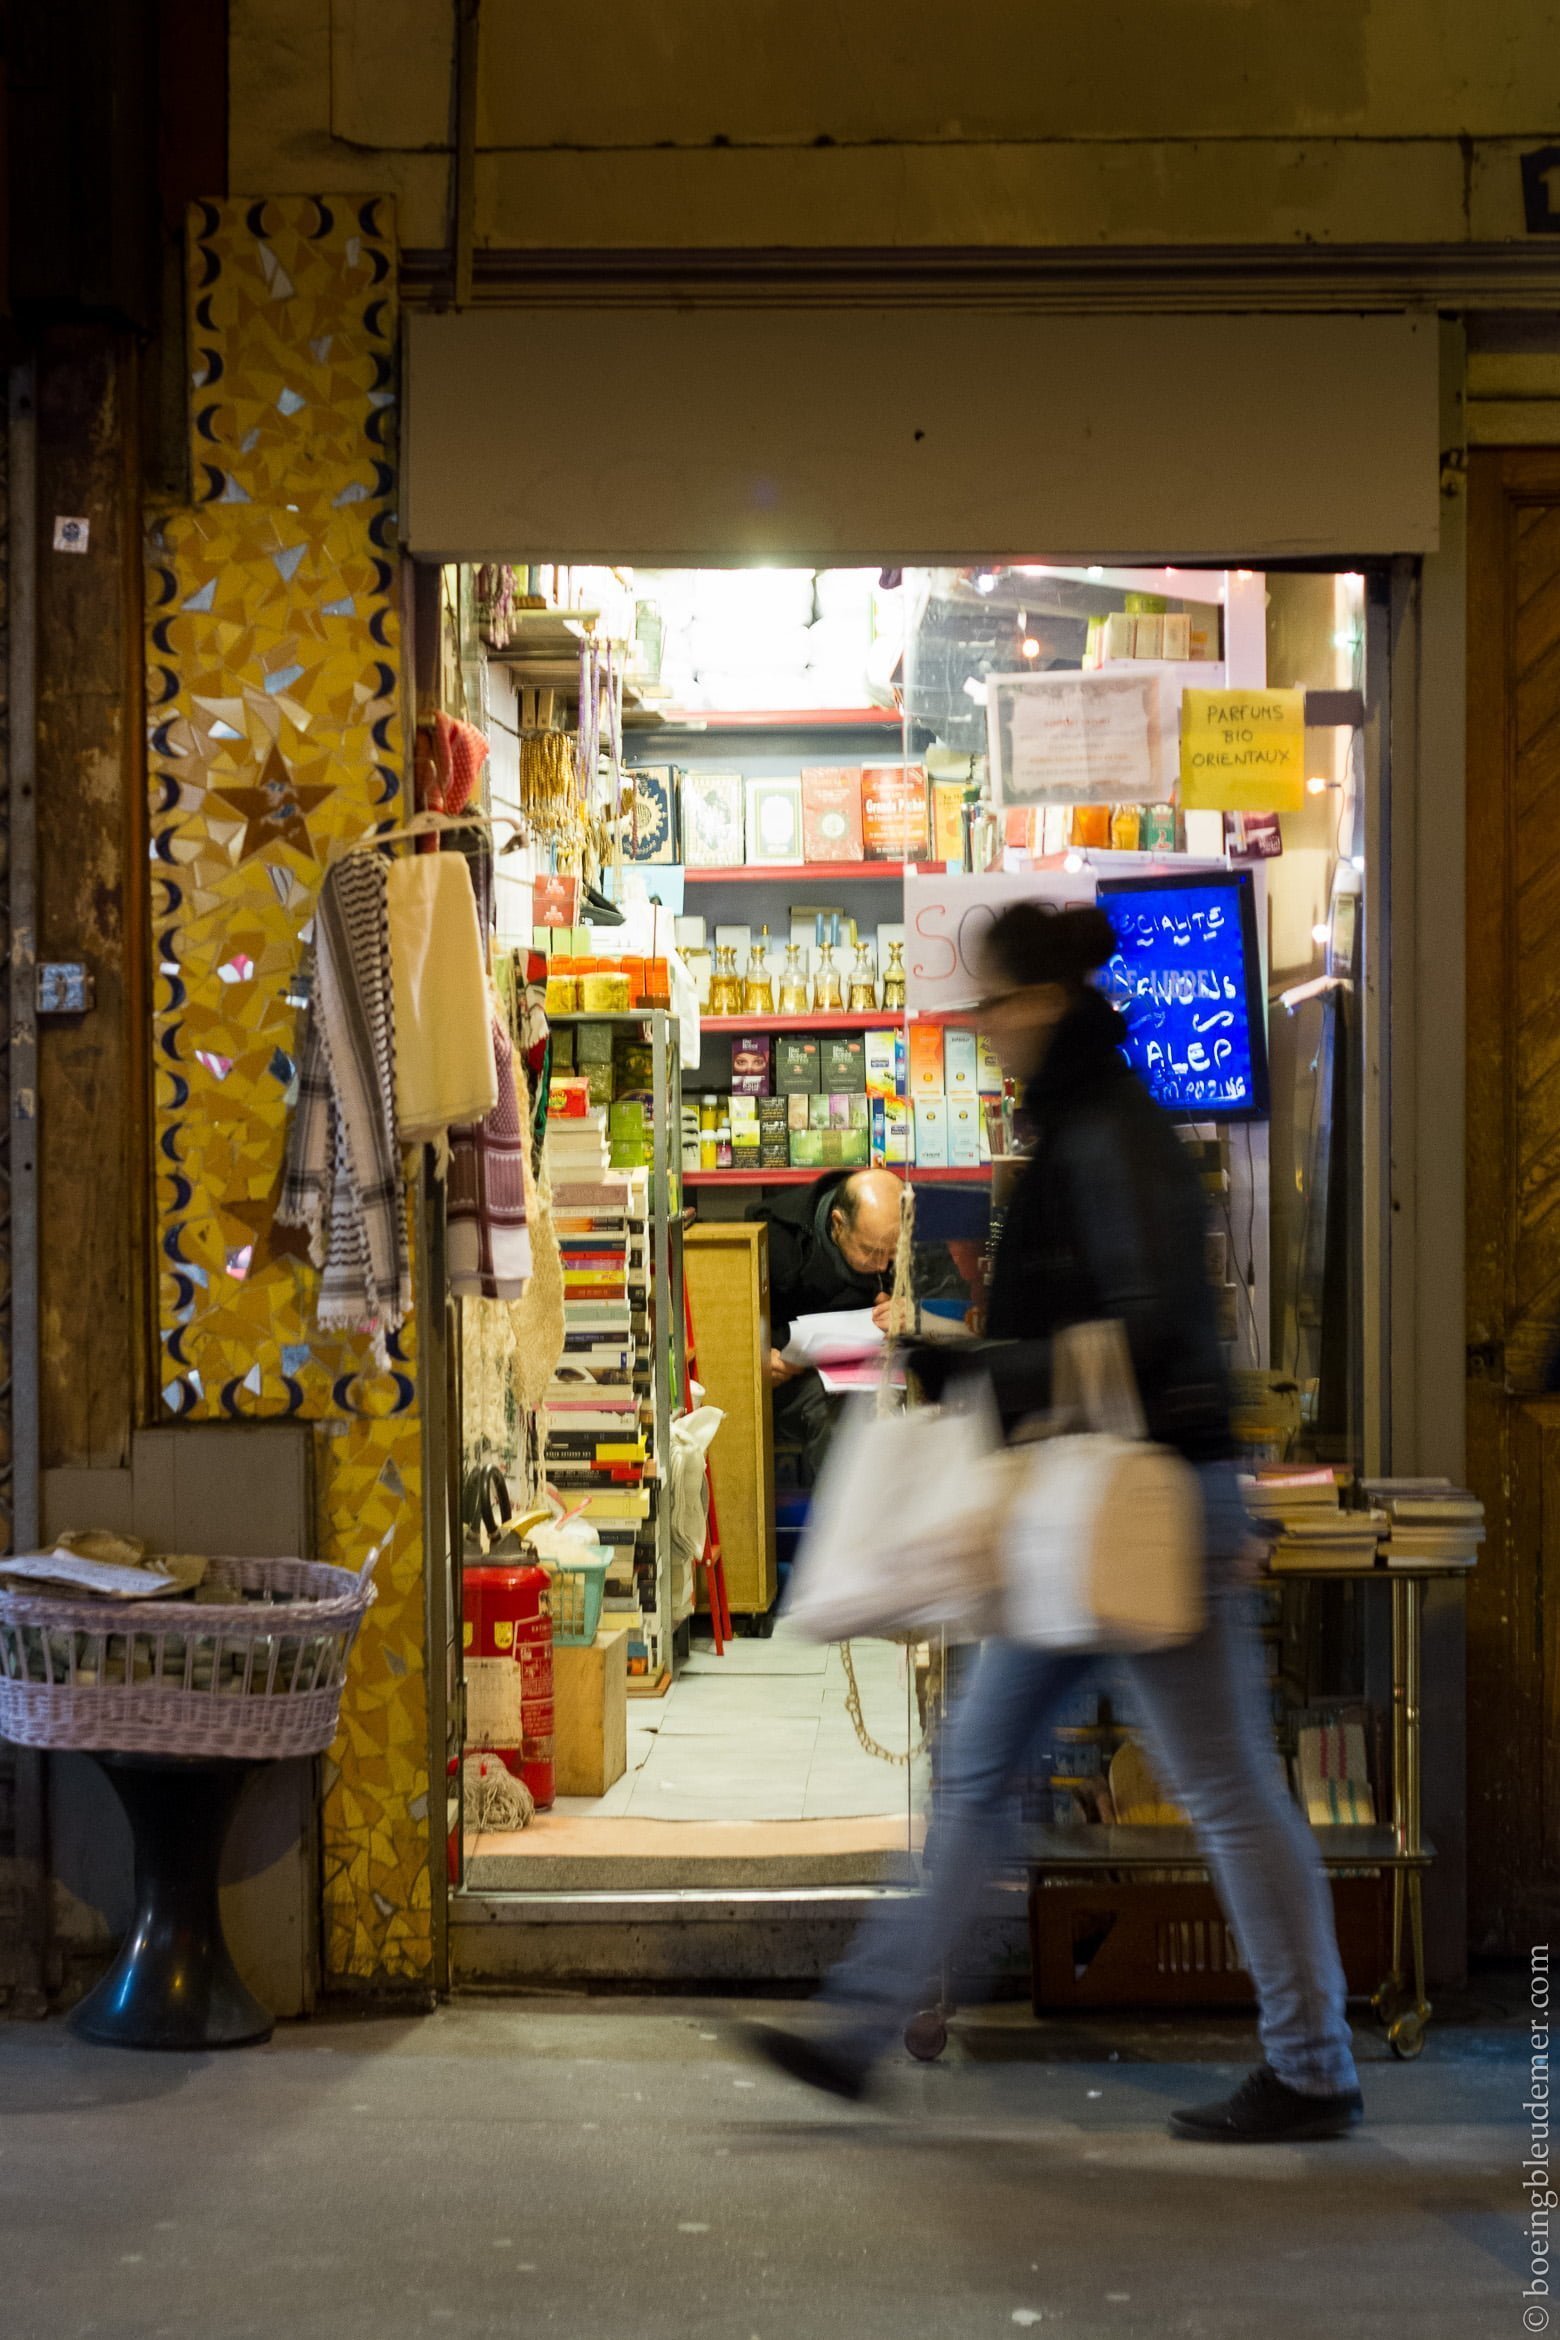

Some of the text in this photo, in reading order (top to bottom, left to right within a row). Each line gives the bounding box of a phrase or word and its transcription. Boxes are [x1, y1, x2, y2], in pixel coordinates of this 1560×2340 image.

[1207, 704, 1285, 724] PARFUMS
[1222, 729, 1254, 744] BIO
[1191, 748, 1291, 768] ORIENTAUX
